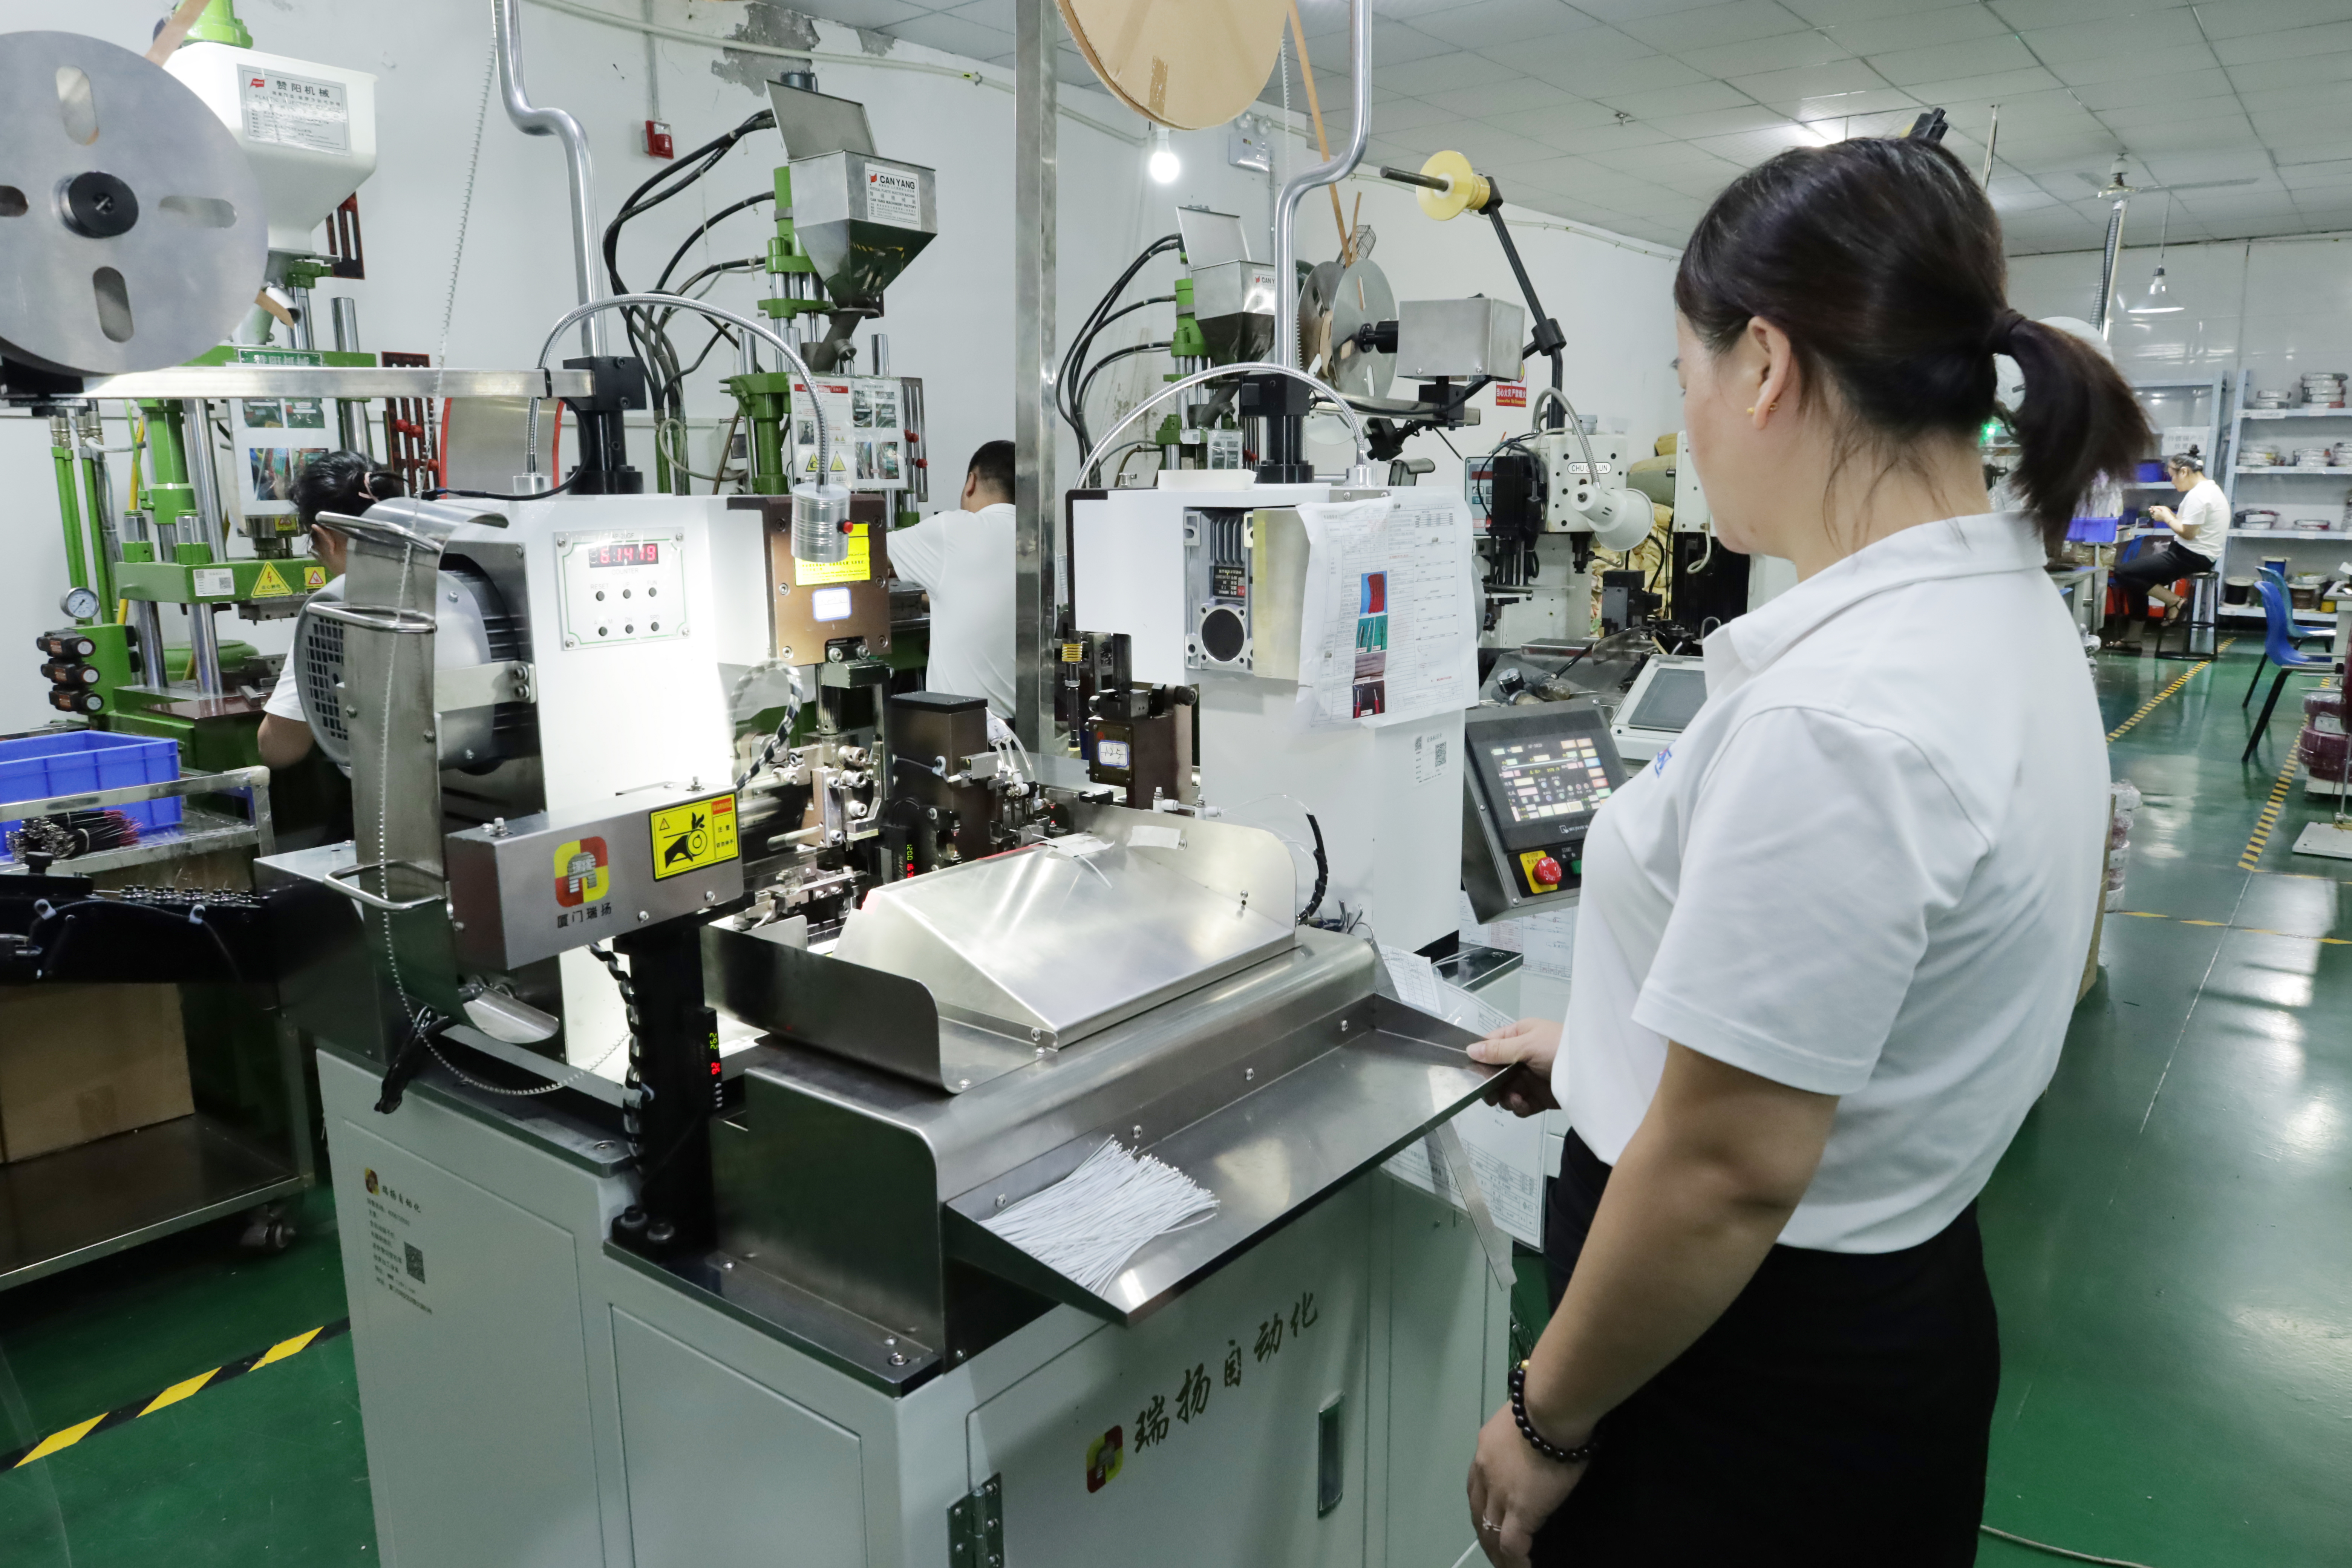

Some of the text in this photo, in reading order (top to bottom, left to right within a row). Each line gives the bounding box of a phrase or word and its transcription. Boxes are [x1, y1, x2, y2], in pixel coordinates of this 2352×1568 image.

[277, 80, 329, 98] 赞阳机械
[880, 176, 895, 185] CAN
[896, 178, 915, 189] YANG
[712, 801, 732, 811] WARNING
[557, 902, 611, 928] 厦门瑞扬
[709, 1033, 718, 1049] 292
[711, 1062, 721, 1075] 26
[1134, 1292, 1318, 1454] 瑞扬自动化
